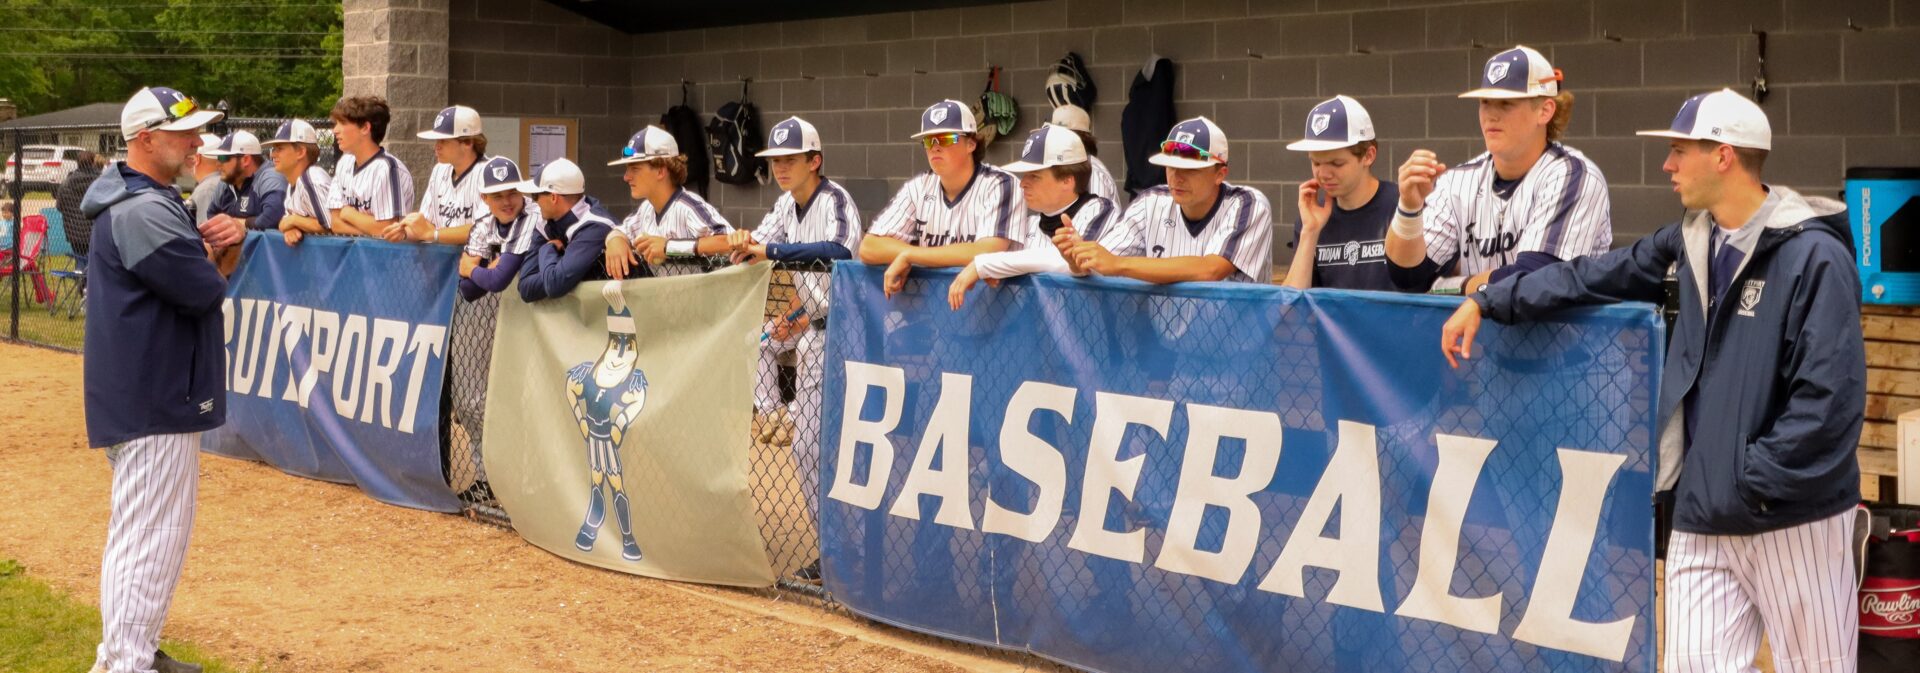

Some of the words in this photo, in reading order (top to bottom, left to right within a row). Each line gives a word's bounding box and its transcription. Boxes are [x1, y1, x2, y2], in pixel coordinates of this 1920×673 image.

[1318, 247, 1342, 263] TROJAN
[1862, 187, 1871, 267] POWERADE
[828, 360, 1636, 662] BASEBALL
